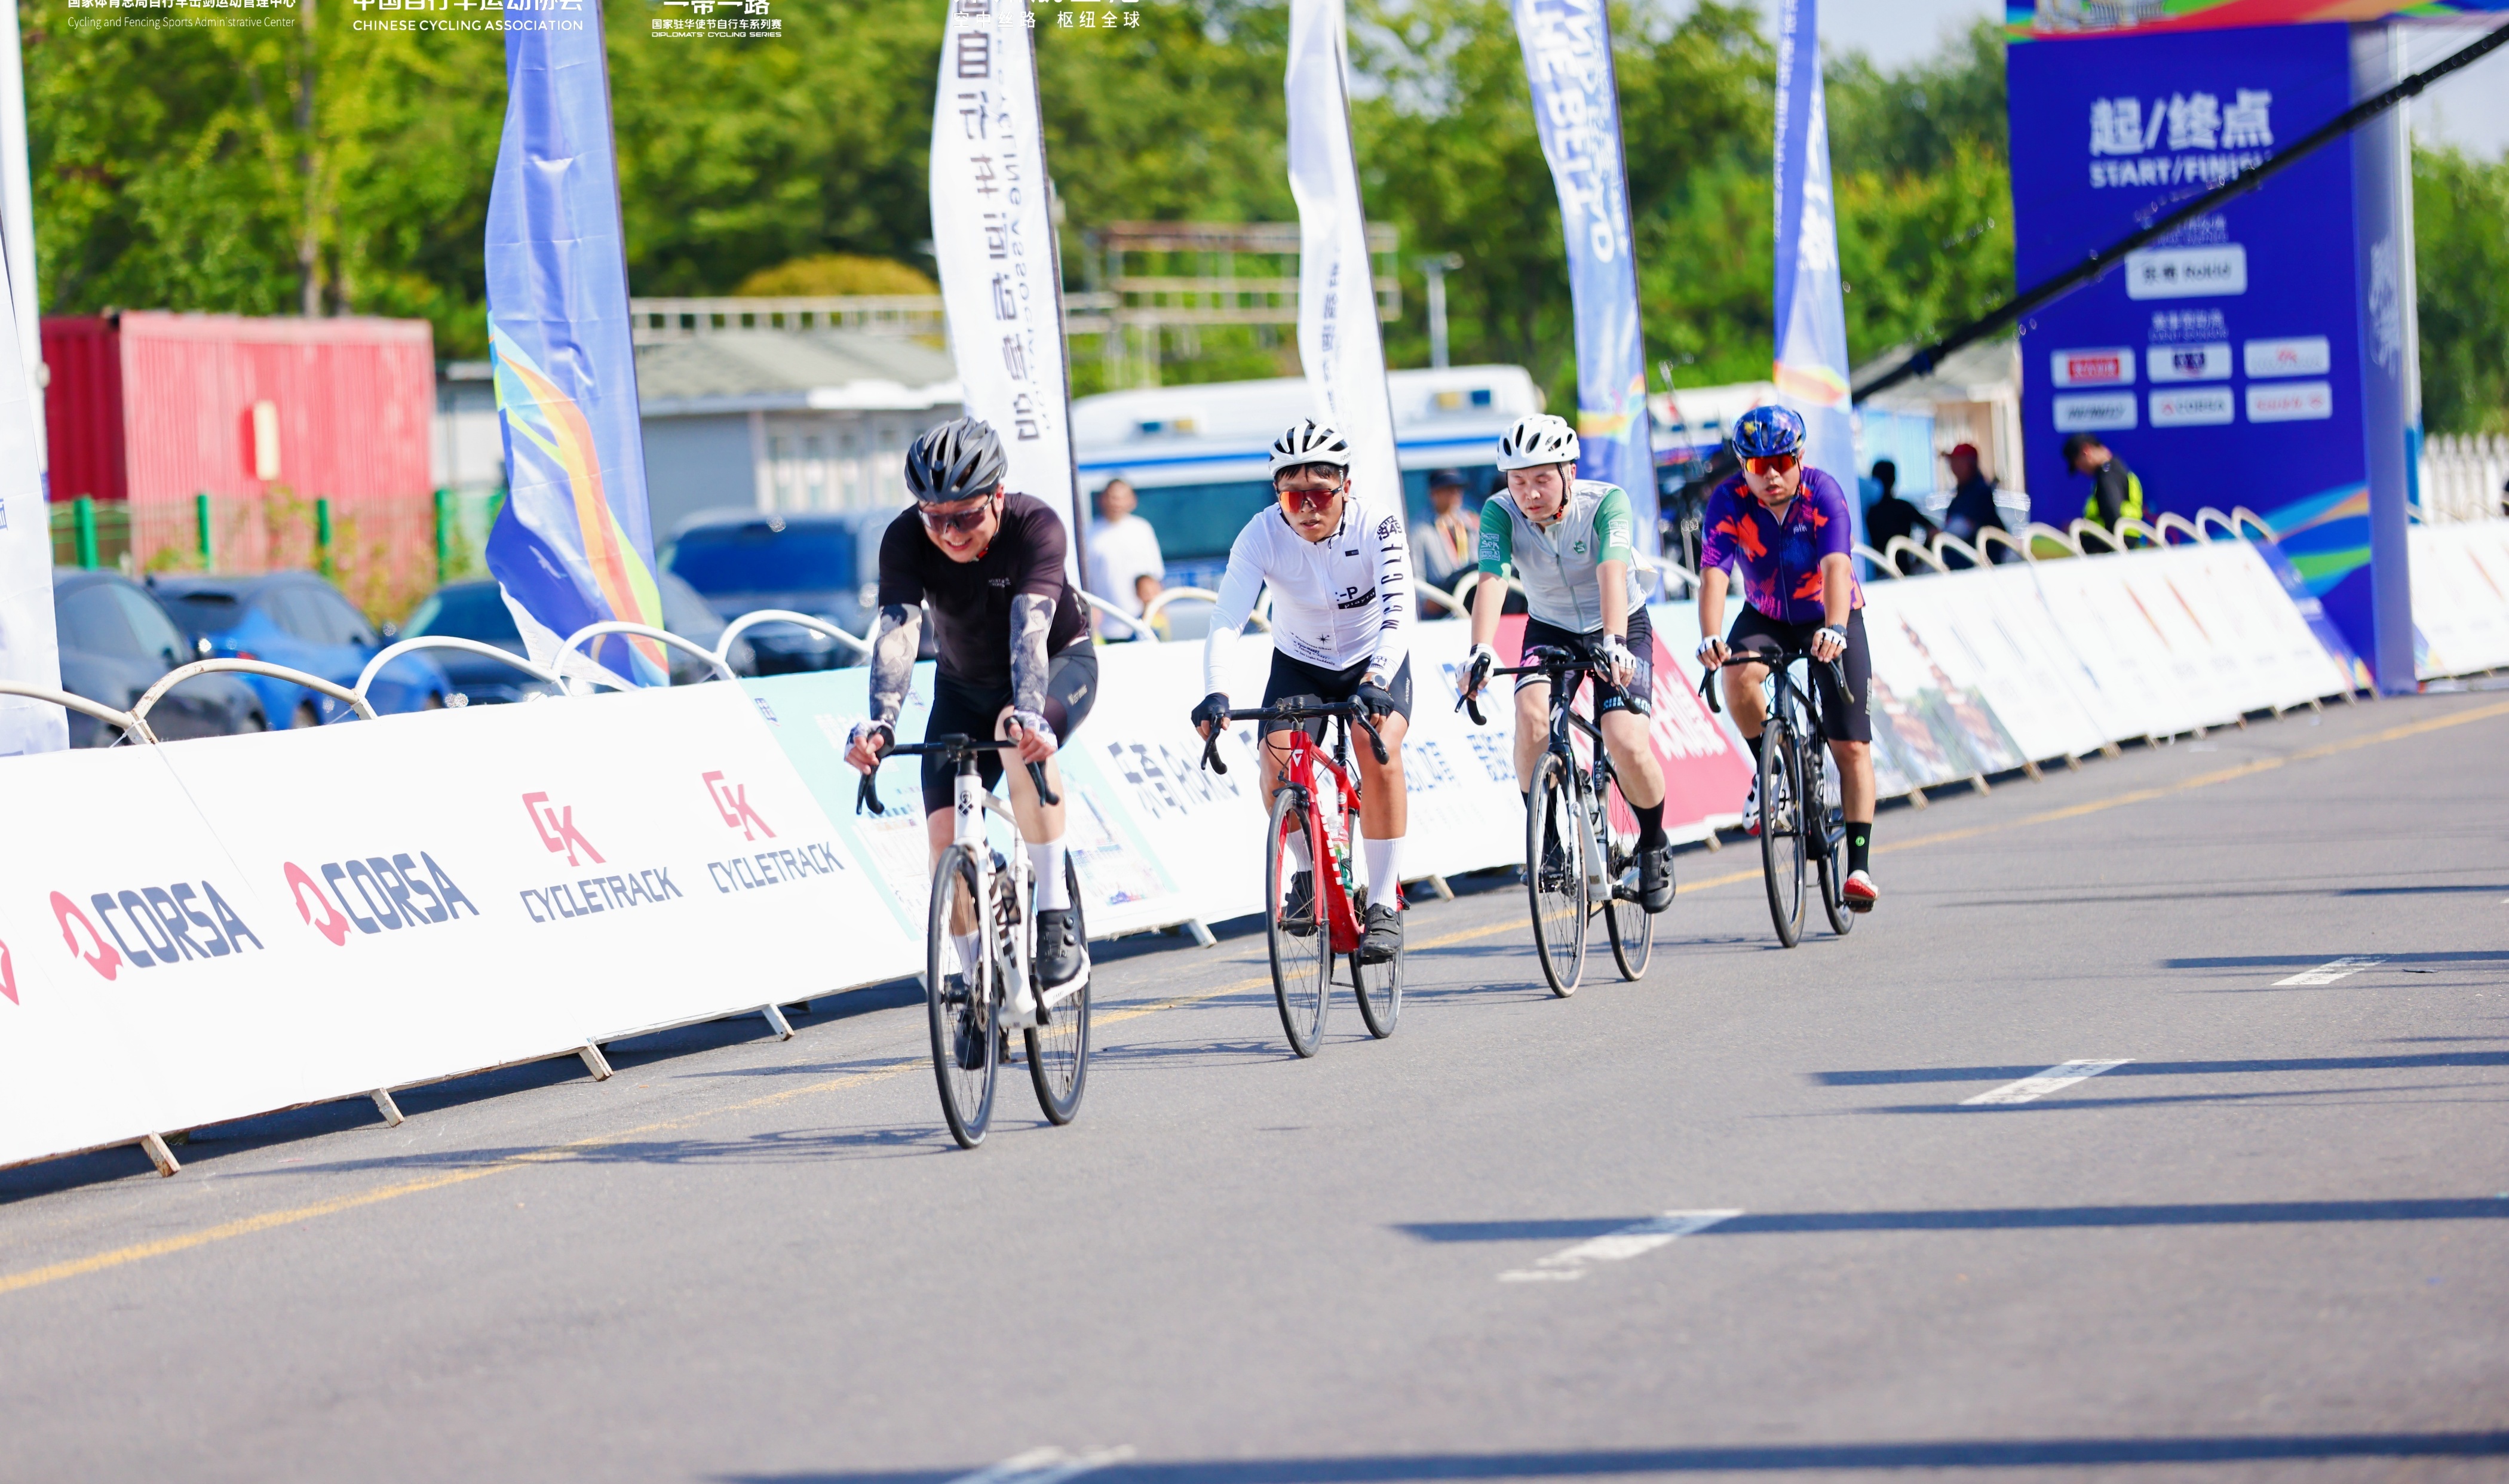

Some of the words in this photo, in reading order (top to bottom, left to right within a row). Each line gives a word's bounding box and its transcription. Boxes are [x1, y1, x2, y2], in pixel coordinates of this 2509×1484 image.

[2090, 87, 2274, 157] 起/终点
[1316, 657, 1335, 666] Suddenly
[321, 850, 480, 935] CORSA
[520, 867, 683, 924] CYCLETRACK
[707, 841, 846, 894] CYCLETRACK
[91, 880, 265, 969] CORSA
